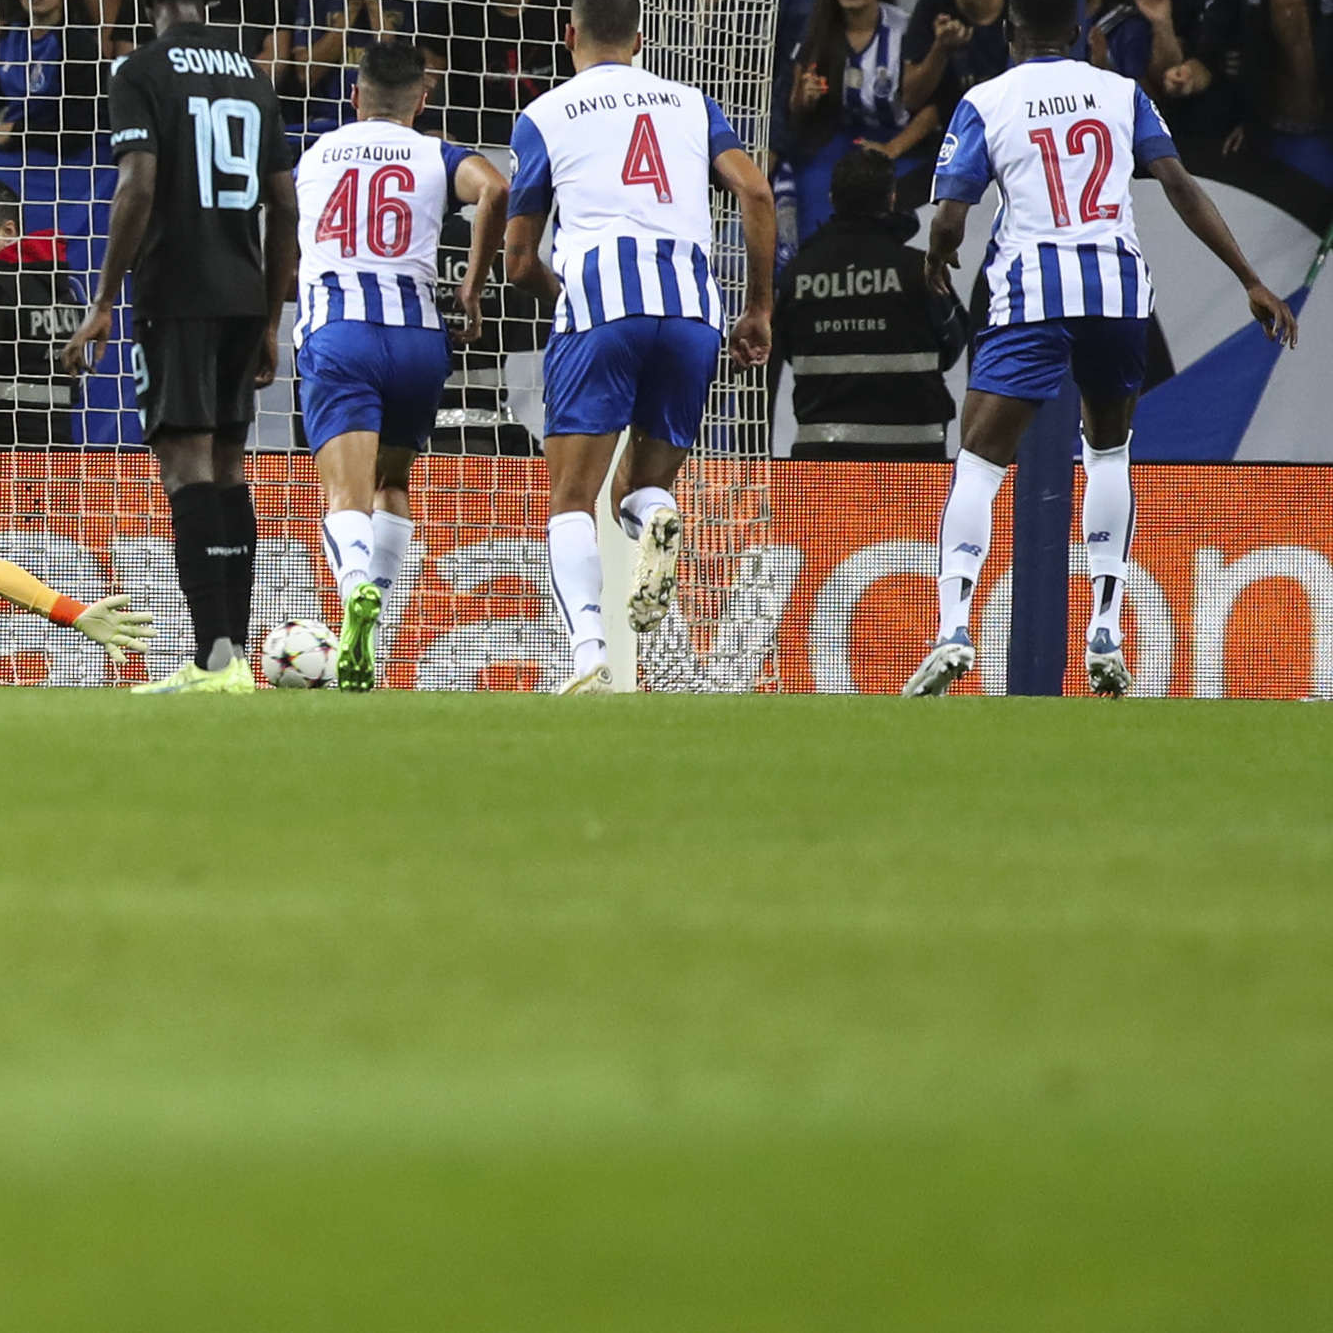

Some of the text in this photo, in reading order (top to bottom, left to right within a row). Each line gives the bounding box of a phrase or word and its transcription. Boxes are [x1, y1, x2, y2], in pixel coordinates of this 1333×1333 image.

[167, 46, 254, 79] SOWAH
[563, 90, 682, 120] DAVID CARMO
[1026, 92, 1103, 120] ZAIDU M.
[187, 95, 262, 211] 19
[620, 113, 673, 205] 4
[1028, 117, 1120, 228] 12
[315, 163, 415, 259] 46
[794, 266, 902, 301] POLÍCIA
[815, 318, 887, 334] SPOTTERS
